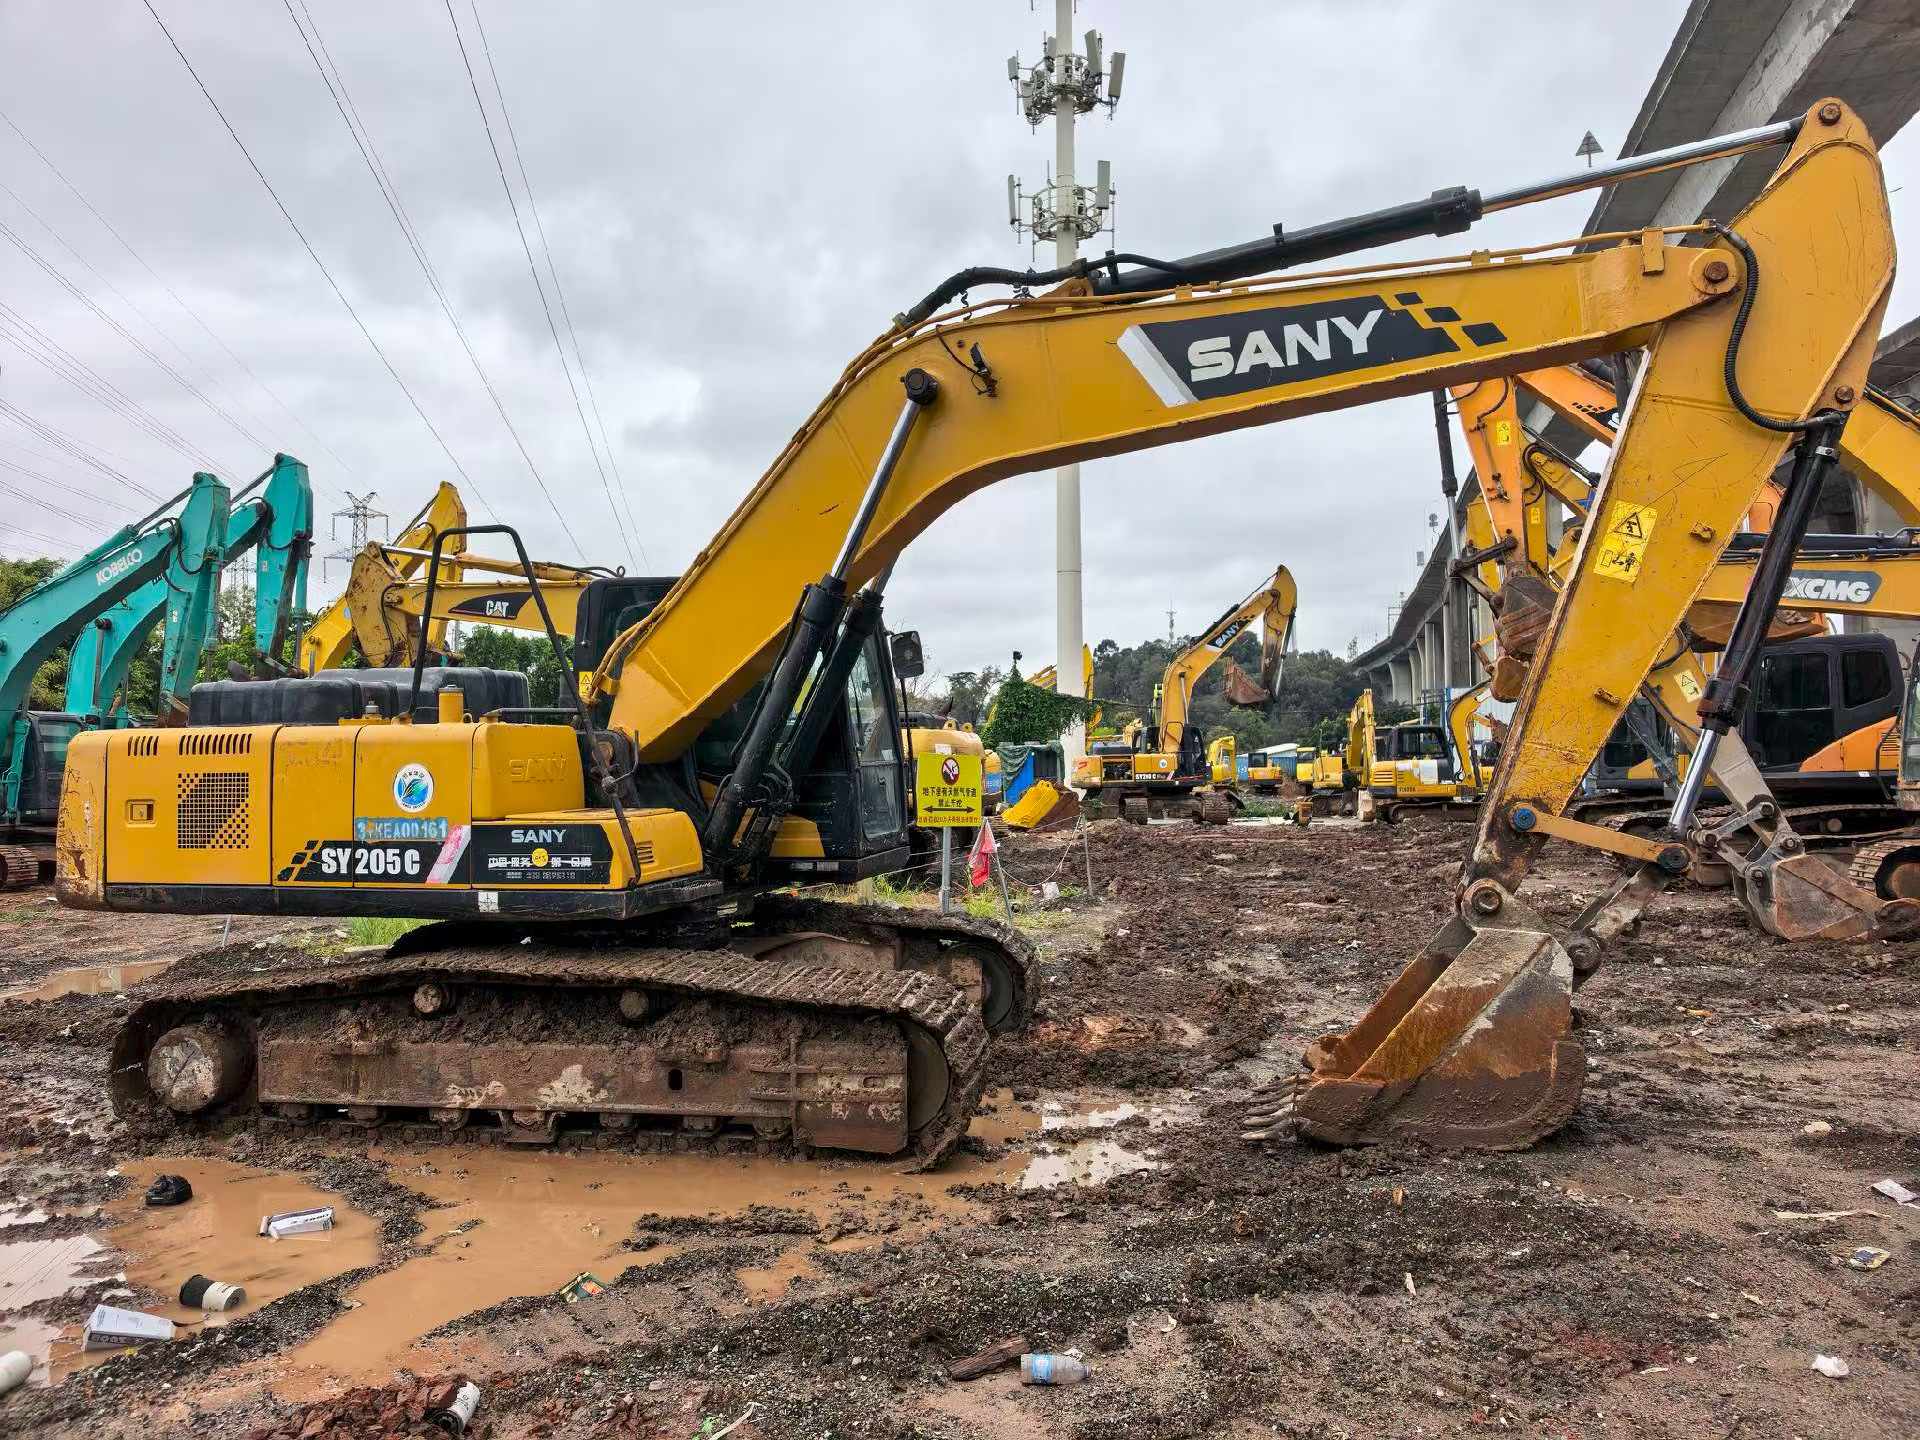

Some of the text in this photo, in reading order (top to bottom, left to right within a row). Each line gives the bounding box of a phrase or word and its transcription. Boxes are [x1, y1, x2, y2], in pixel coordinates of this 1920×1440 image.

[1187, 309, 1385, 382] SANY
[95, 548, 143, 586] KOBELCO
[1781, 576, 1872, 603] XCMG
[486, 600, 509, 617] CAT
[1215, 621, 1240, 648] SANY
[511, 829, 567, 843] SANY
